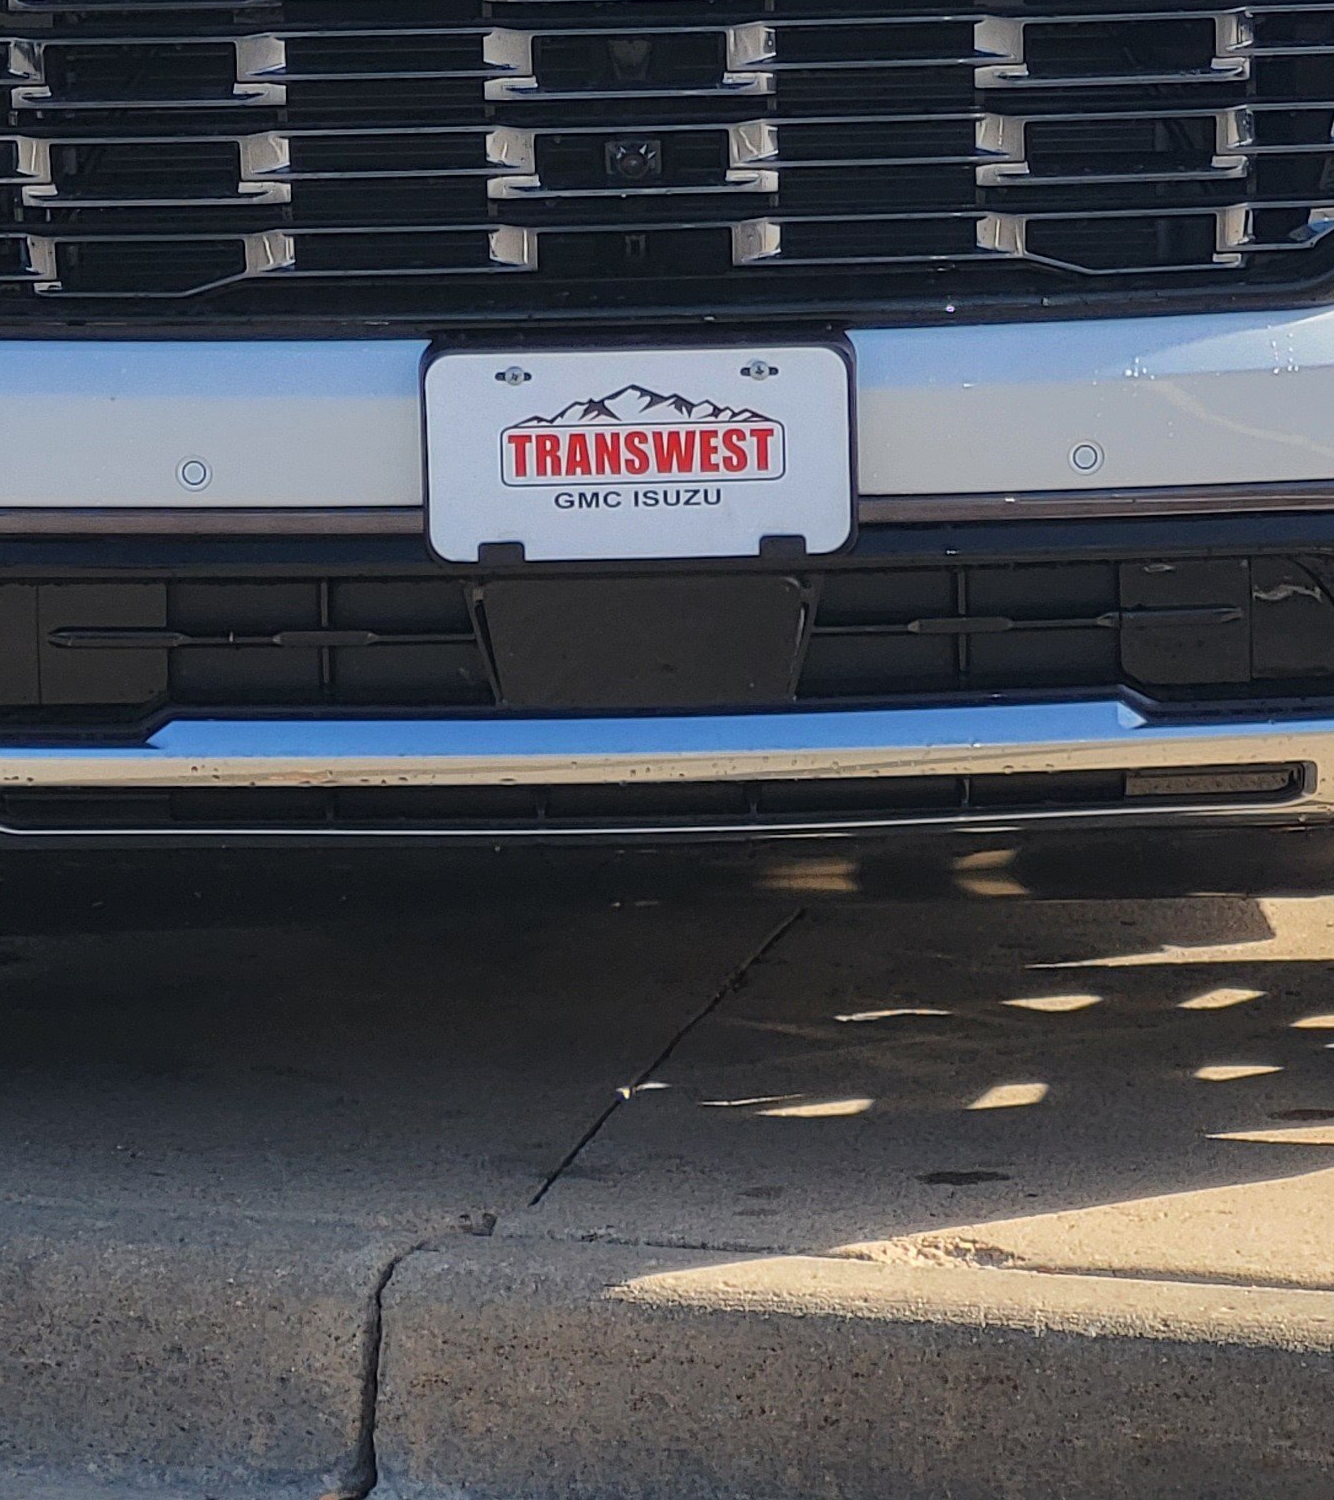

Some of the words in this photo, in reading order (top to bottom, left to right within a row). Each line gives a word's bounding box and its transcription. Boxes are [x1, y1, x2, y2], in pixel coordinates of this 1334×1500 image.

[507, 428, 775, 477] TRANSWEST
[554, 491, 623, 509] GMC
[633, 488, 723, 508] ISUZU
